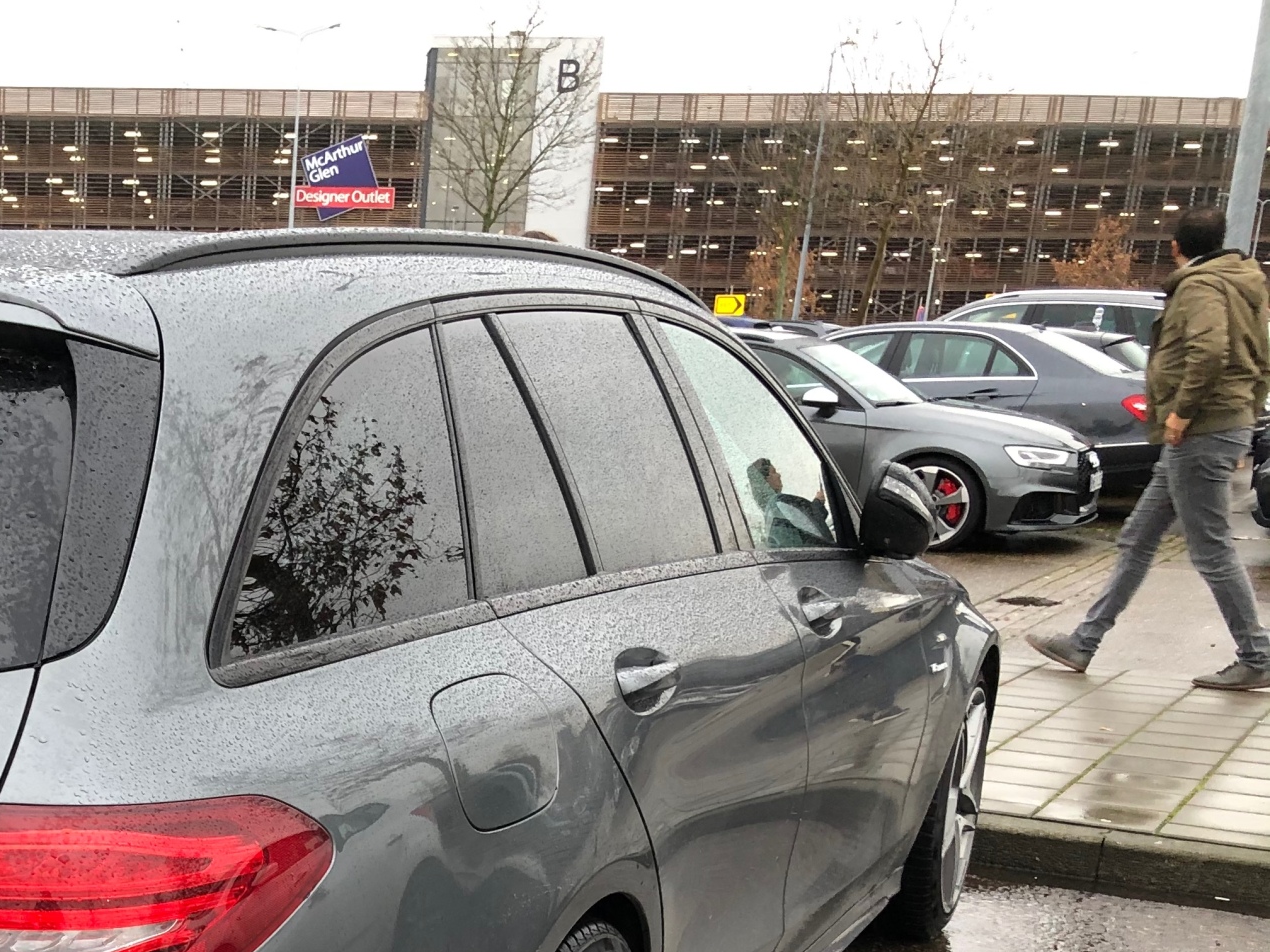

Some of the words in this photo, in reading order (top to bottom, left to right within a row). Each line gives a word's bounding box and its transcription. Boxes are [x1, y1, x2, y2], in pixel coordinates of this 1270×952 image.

[557, 59, 580, 93] B
[305, 141, 363, 171] McArthur
[309, 165, 339, 183] Glen
[296, 189, 350, 206] Designer
[351, 190, 390, 204] Outlet
